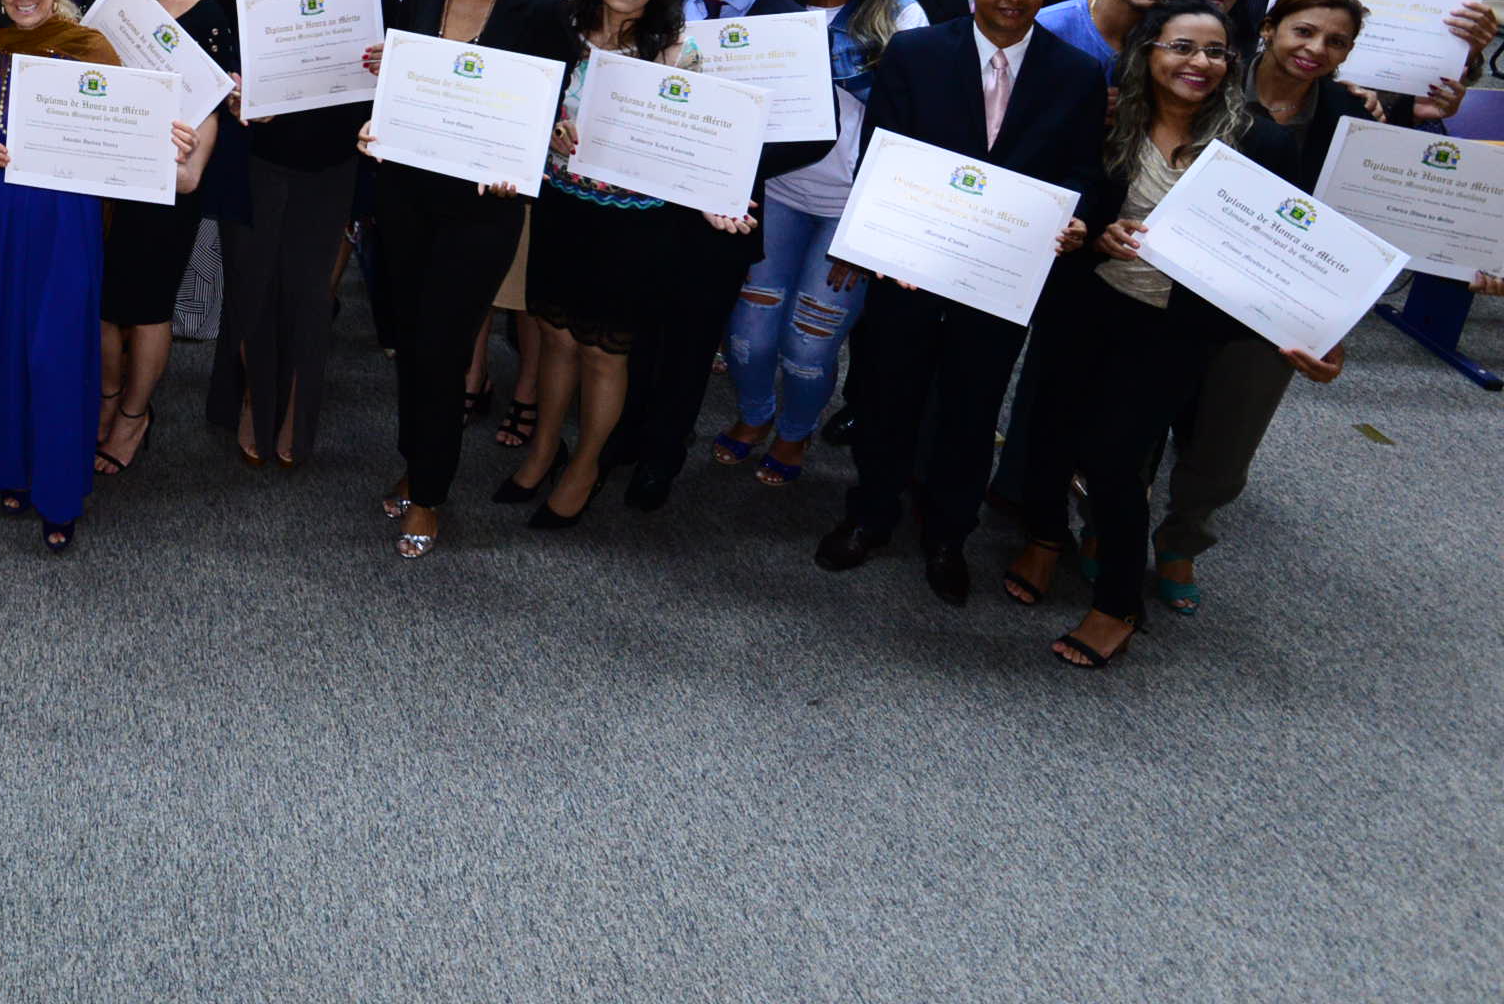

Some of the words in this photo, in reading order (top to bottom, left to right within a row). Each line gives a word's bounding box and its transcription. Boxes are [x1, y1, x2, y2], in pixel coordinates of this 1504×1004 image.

[70, 97, 79, 108] de
[645, 99, 657, 111] de
[1362, 158, 1404, 176] Diploma
[1405, 166, 1417, 178] de
[1421, 169, 1453, 185] Honra
[1455, 176, 1467, 188] ao
[1215, 186, 1256, 218] Diploma
[1255, 210, 1269, 226] de
[1269, 218, 1302, 245] Honra
[1301, 237, 1315, 253] ao
[1315, 246, 1352, 275] Mérito
[1287, 245, 1298, 256] de
